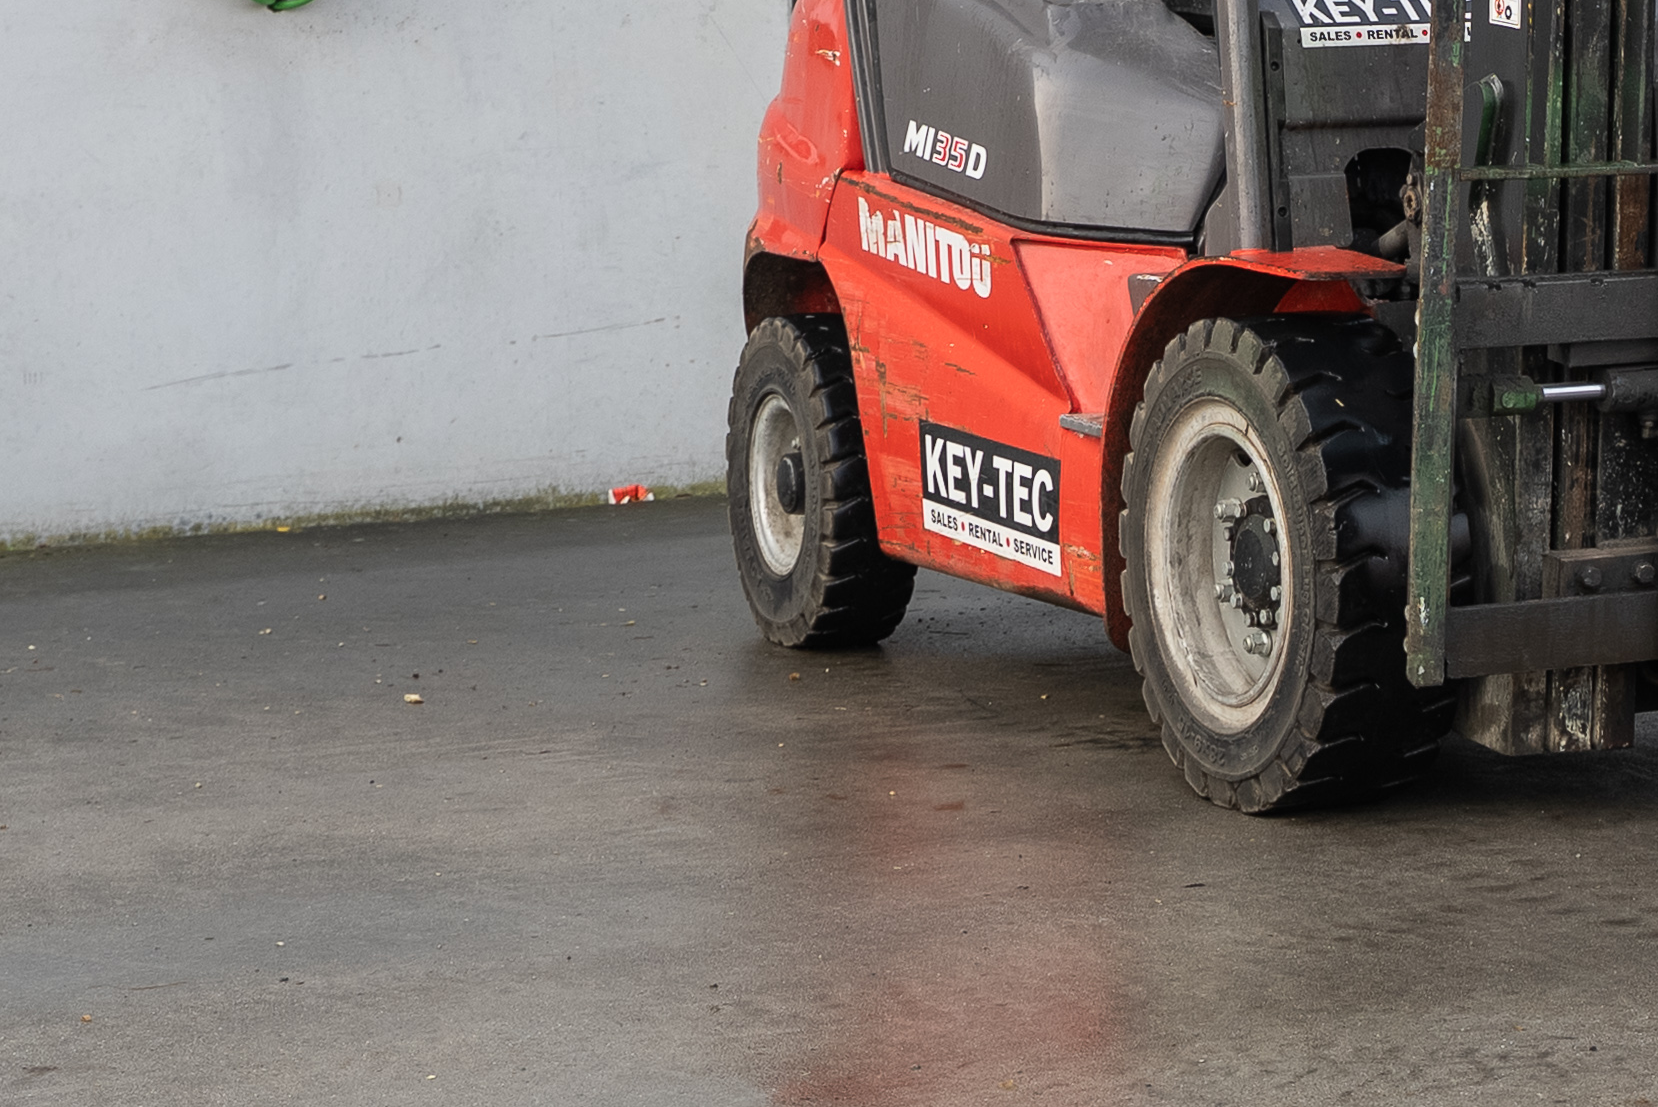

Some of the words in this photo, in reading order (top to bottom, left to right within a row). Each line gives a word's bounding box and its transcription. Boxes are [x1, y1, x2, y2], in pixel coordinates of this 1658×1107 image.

[1309, 30, 1352, 43] SALES
[1366, 27, 1419, 41] RENTAL
[924, 433, 1054, 533] KEY-TEC
[930, 508, 959, 532] SALES
[968, 521, 1004, 548] RENTAL
[1013, 537, 1054, 566] SERVICE
